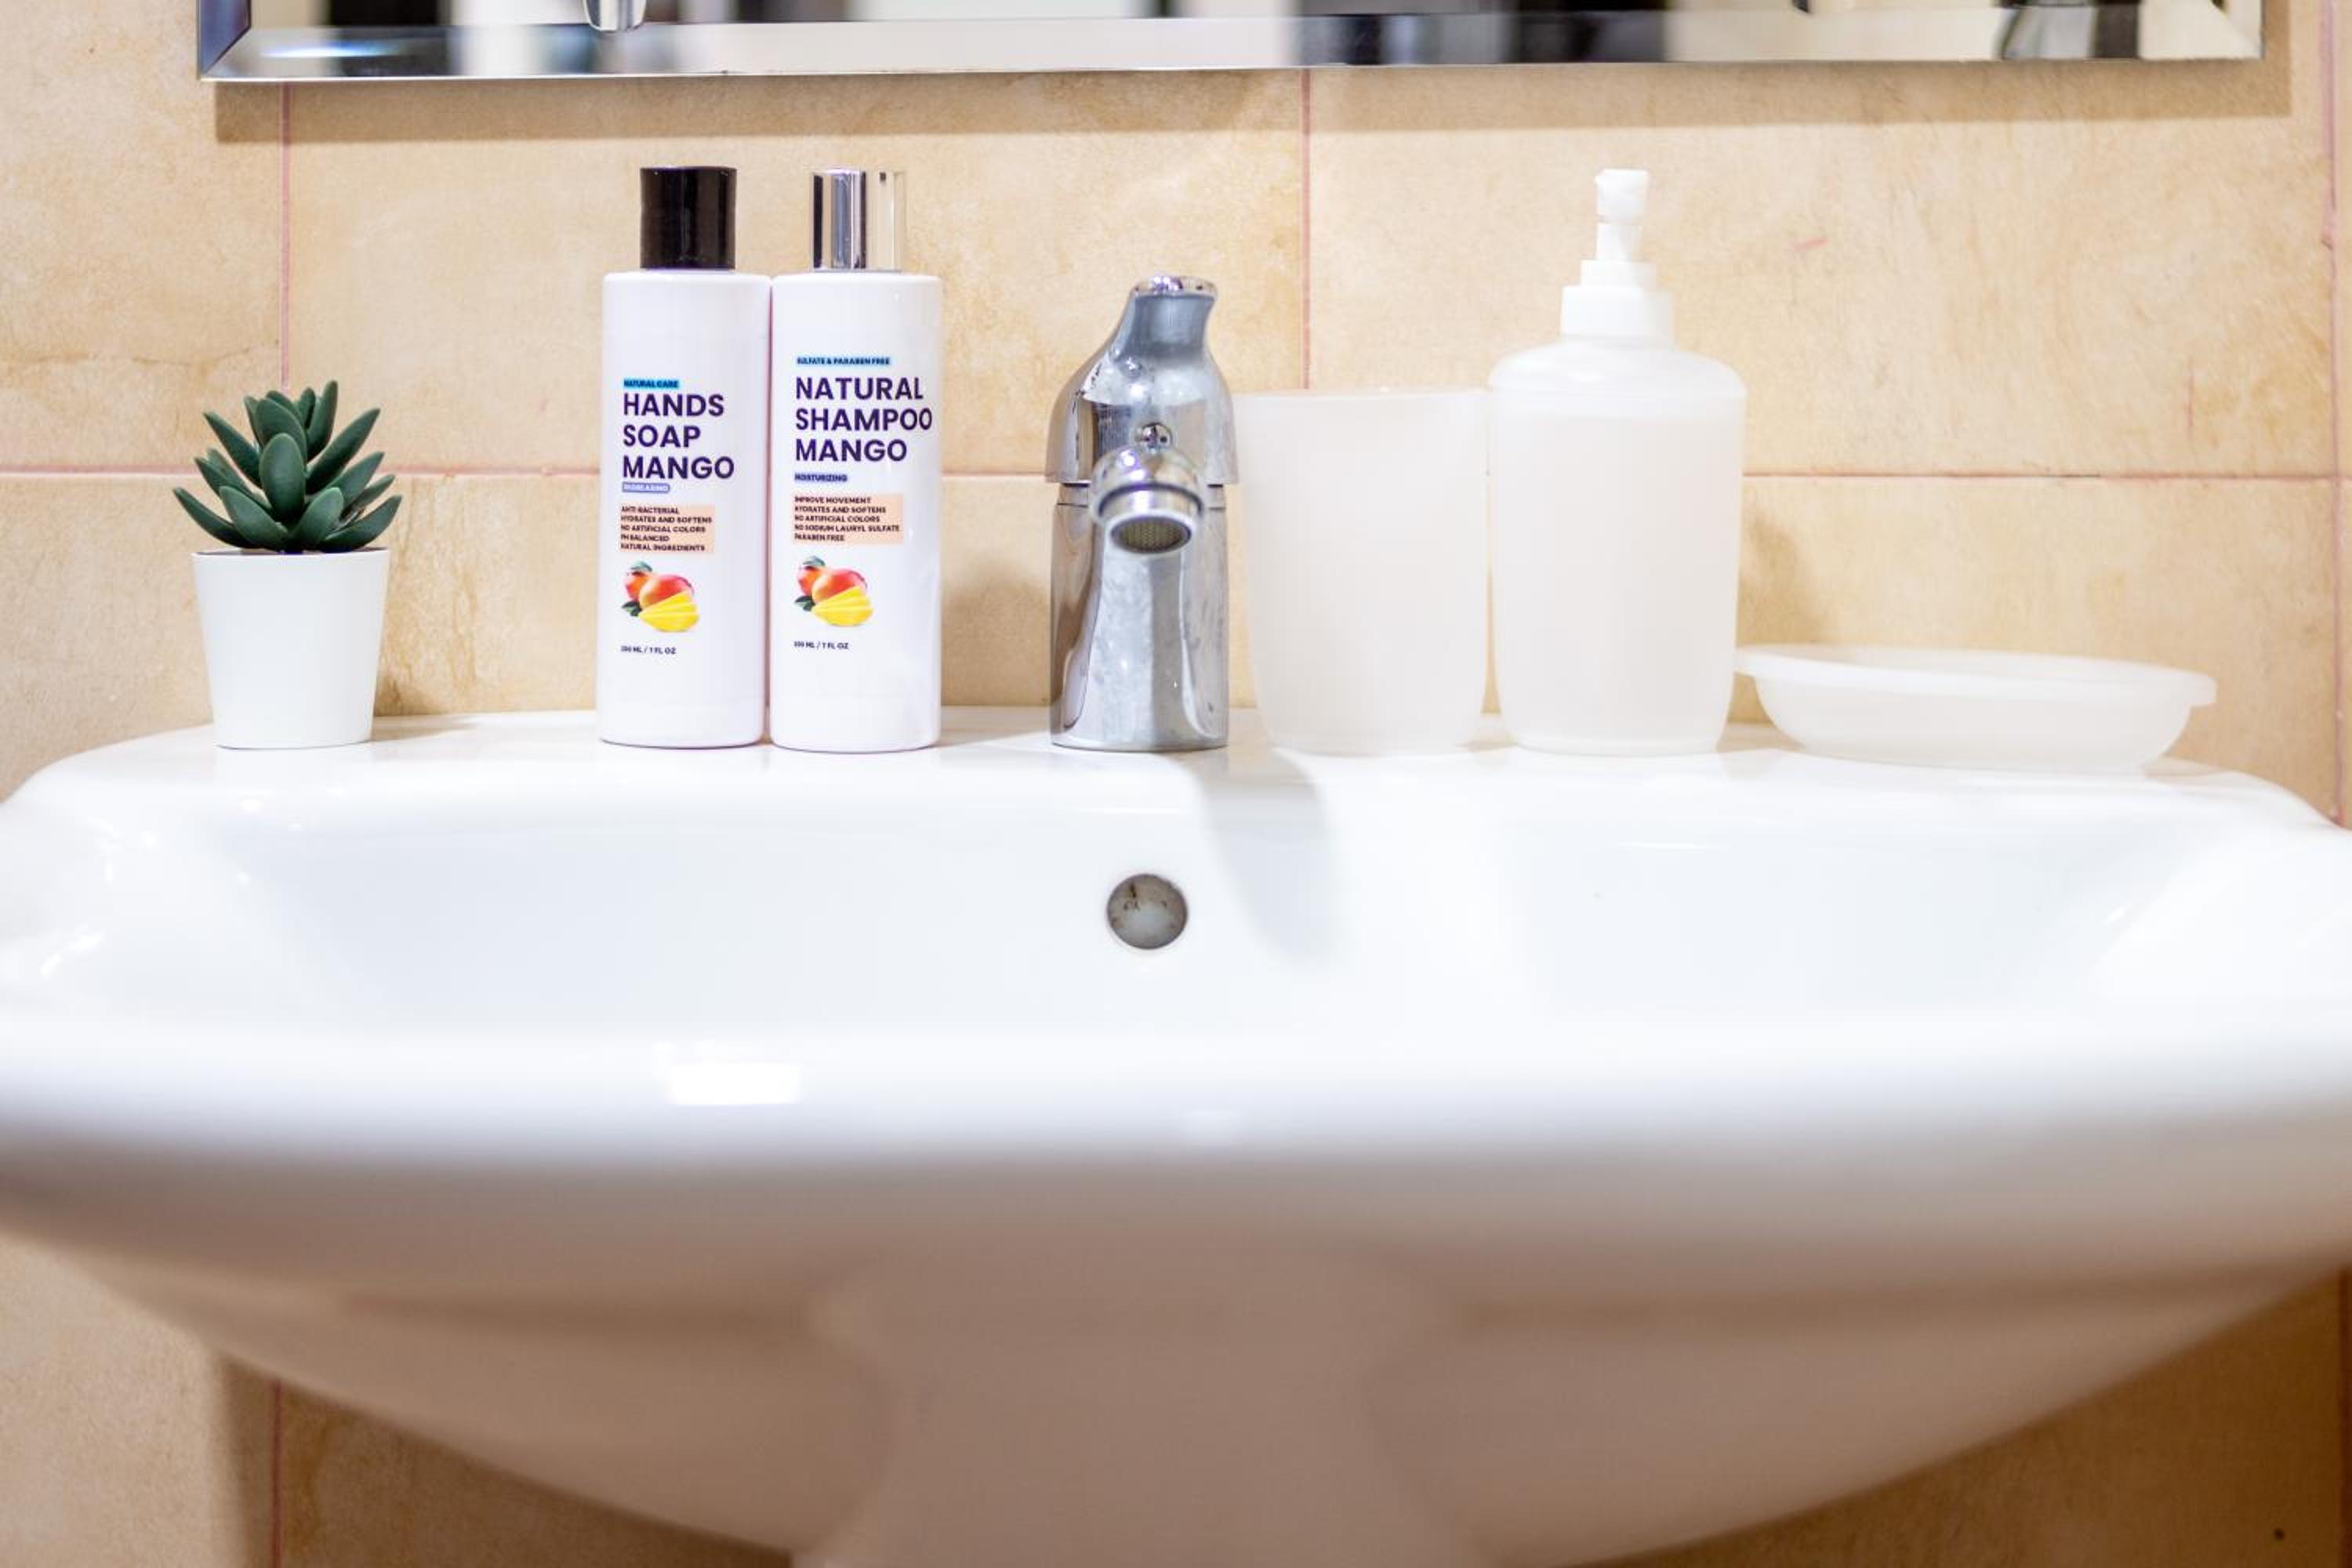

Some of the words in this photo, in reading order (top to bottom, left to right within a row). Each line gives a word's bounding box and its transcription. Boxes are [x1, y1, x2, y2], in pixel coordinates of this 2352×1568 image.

[796, 376, 924, 400] NATURAL
[623, 393, 724, 416] HANDS
[796, 408, 932, 430] SHAMPOO
[623, 424, 701, 448] SOAP
[796, 438, 907, 462] MANGO
[623, 455, 735, 479] MANGO
